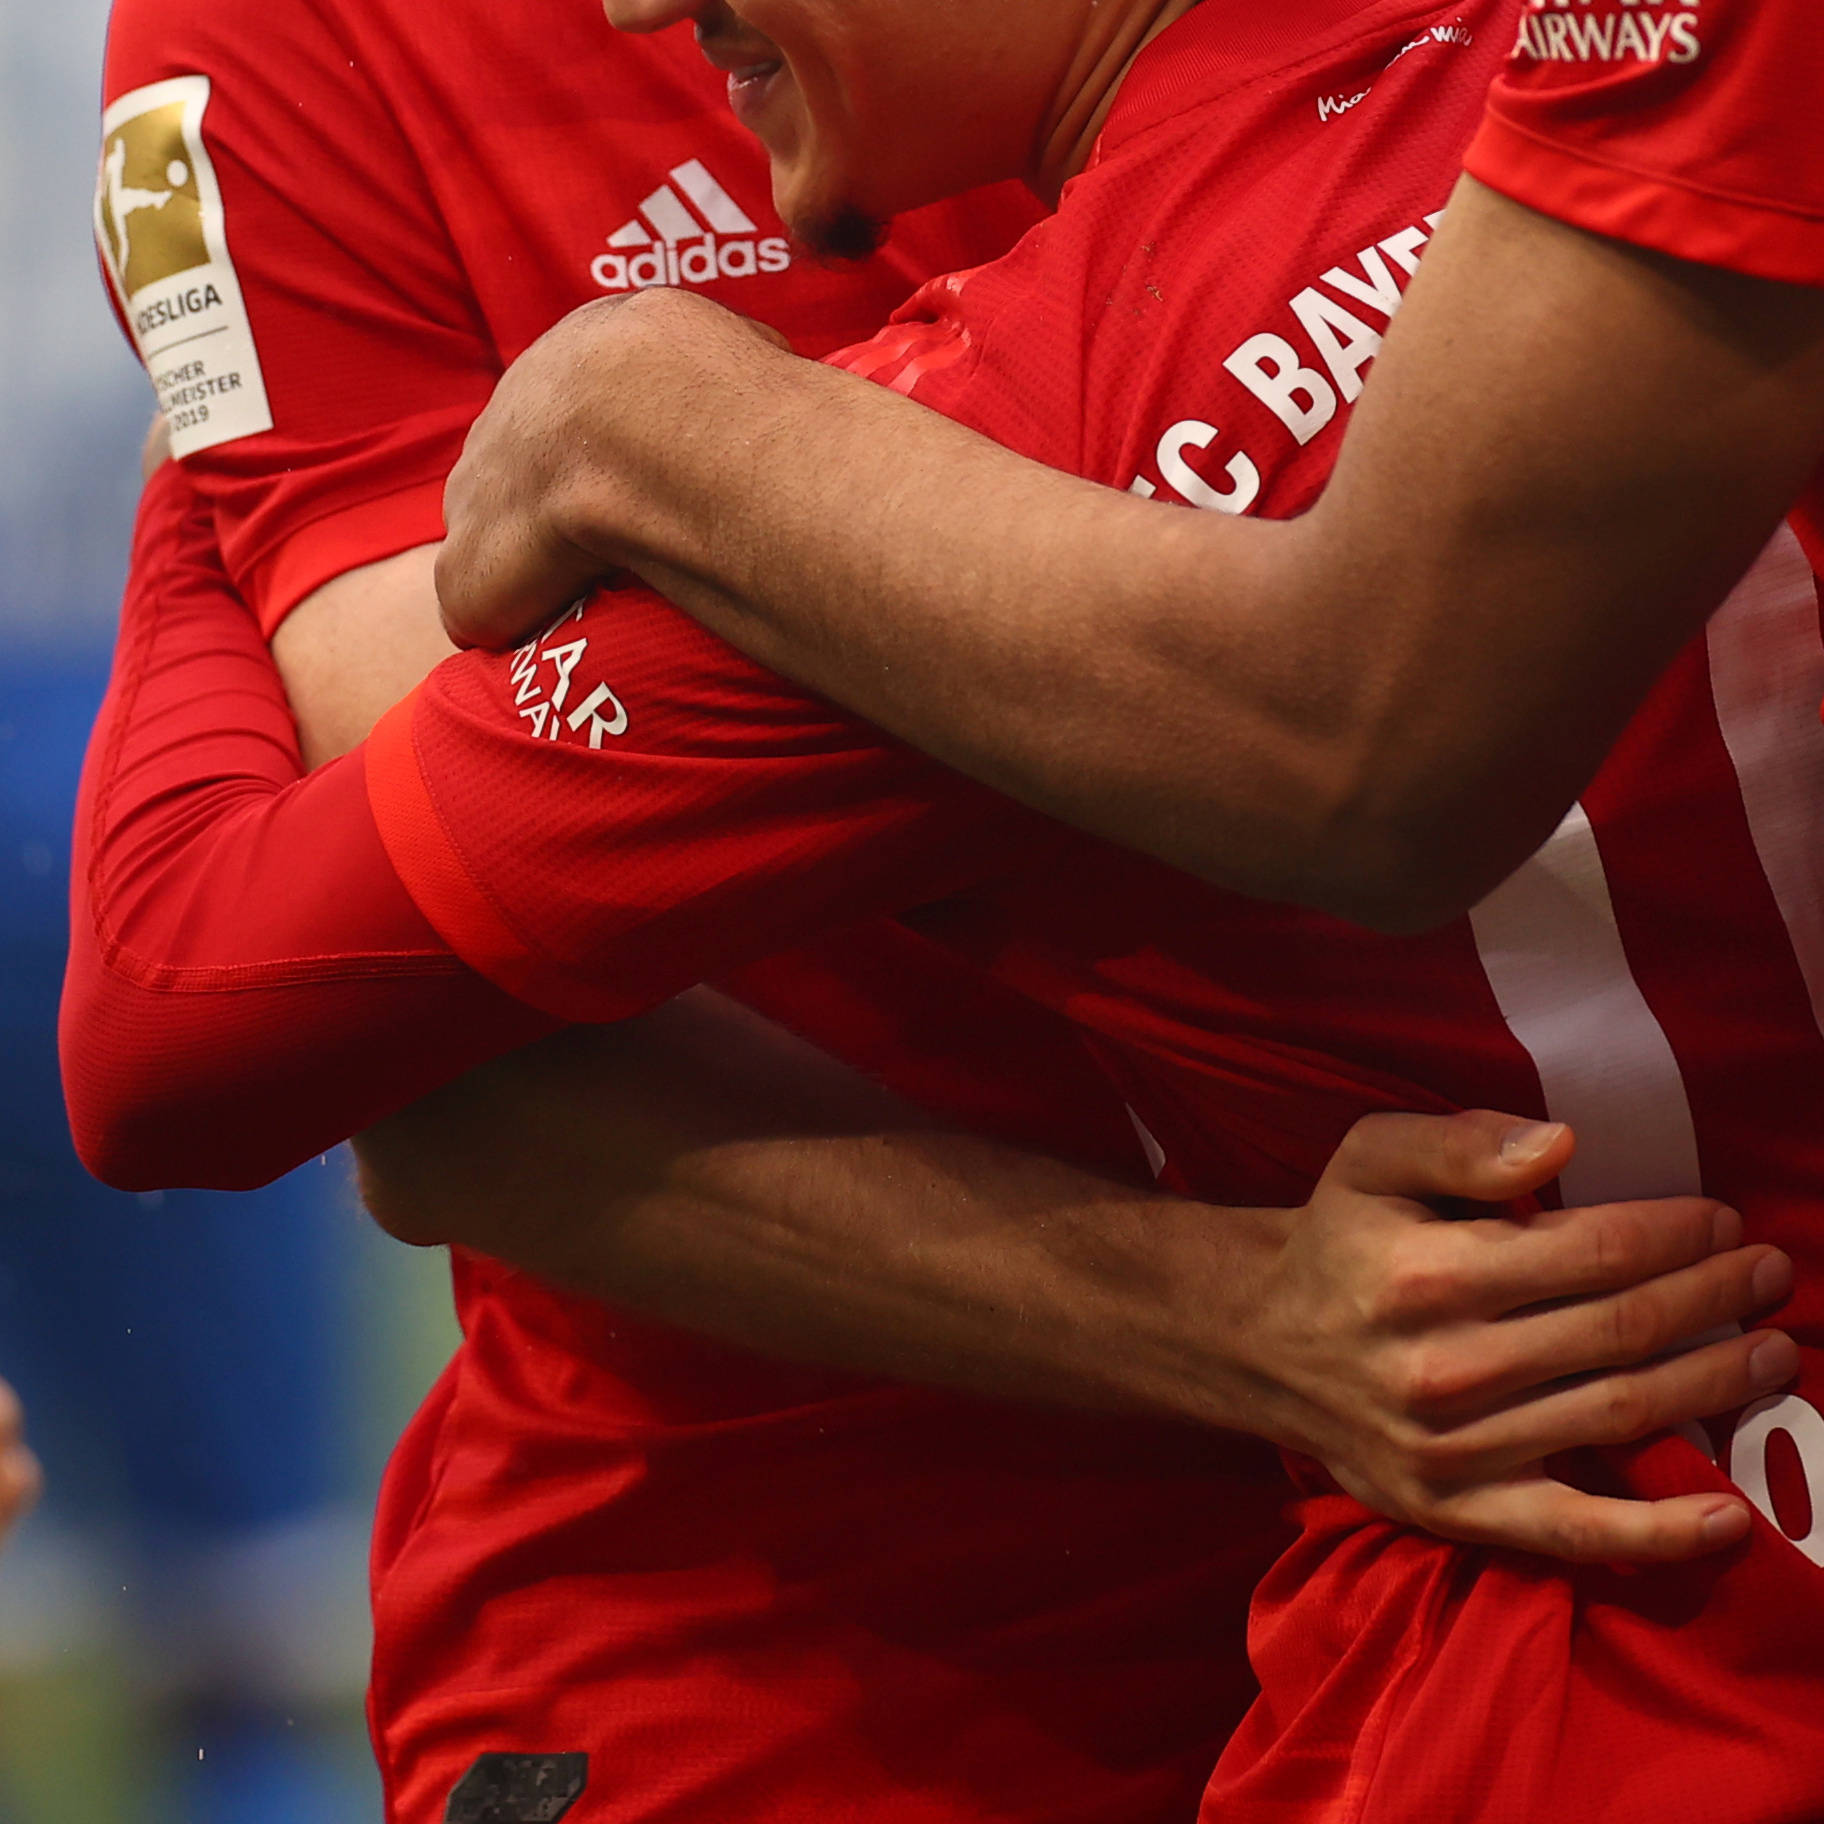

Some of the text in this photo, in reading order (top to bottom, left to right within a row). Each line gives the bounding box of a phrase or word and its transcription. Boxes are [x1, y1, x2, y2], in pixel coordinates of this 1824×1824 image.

[1509, 8, 1702, 65] AIRWAYS
[590, 231, 792, 288] adidas
[1222, 209, 1448, 446] BAY
